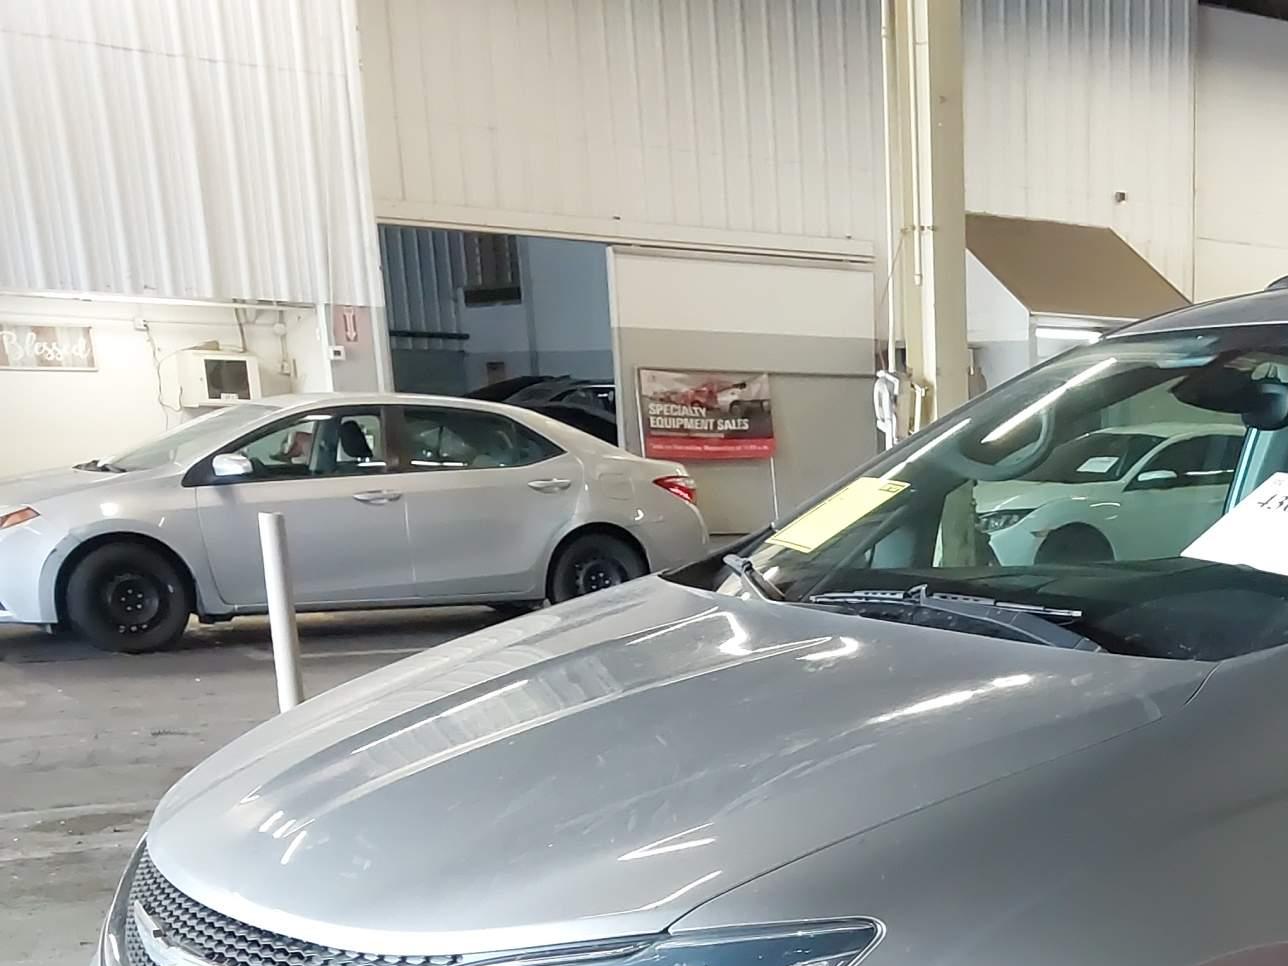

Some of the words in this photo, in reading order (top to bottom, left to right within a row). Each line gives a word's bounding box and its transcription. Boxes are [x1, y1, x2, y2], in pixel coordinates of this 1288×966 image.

[0, 331, 91, 361] Blessed
[648, 403, 707, 417] SPECIALTY
[649, 416, 715, 431] EQUIPMENT
[716, 418, 750, 431] SALES
